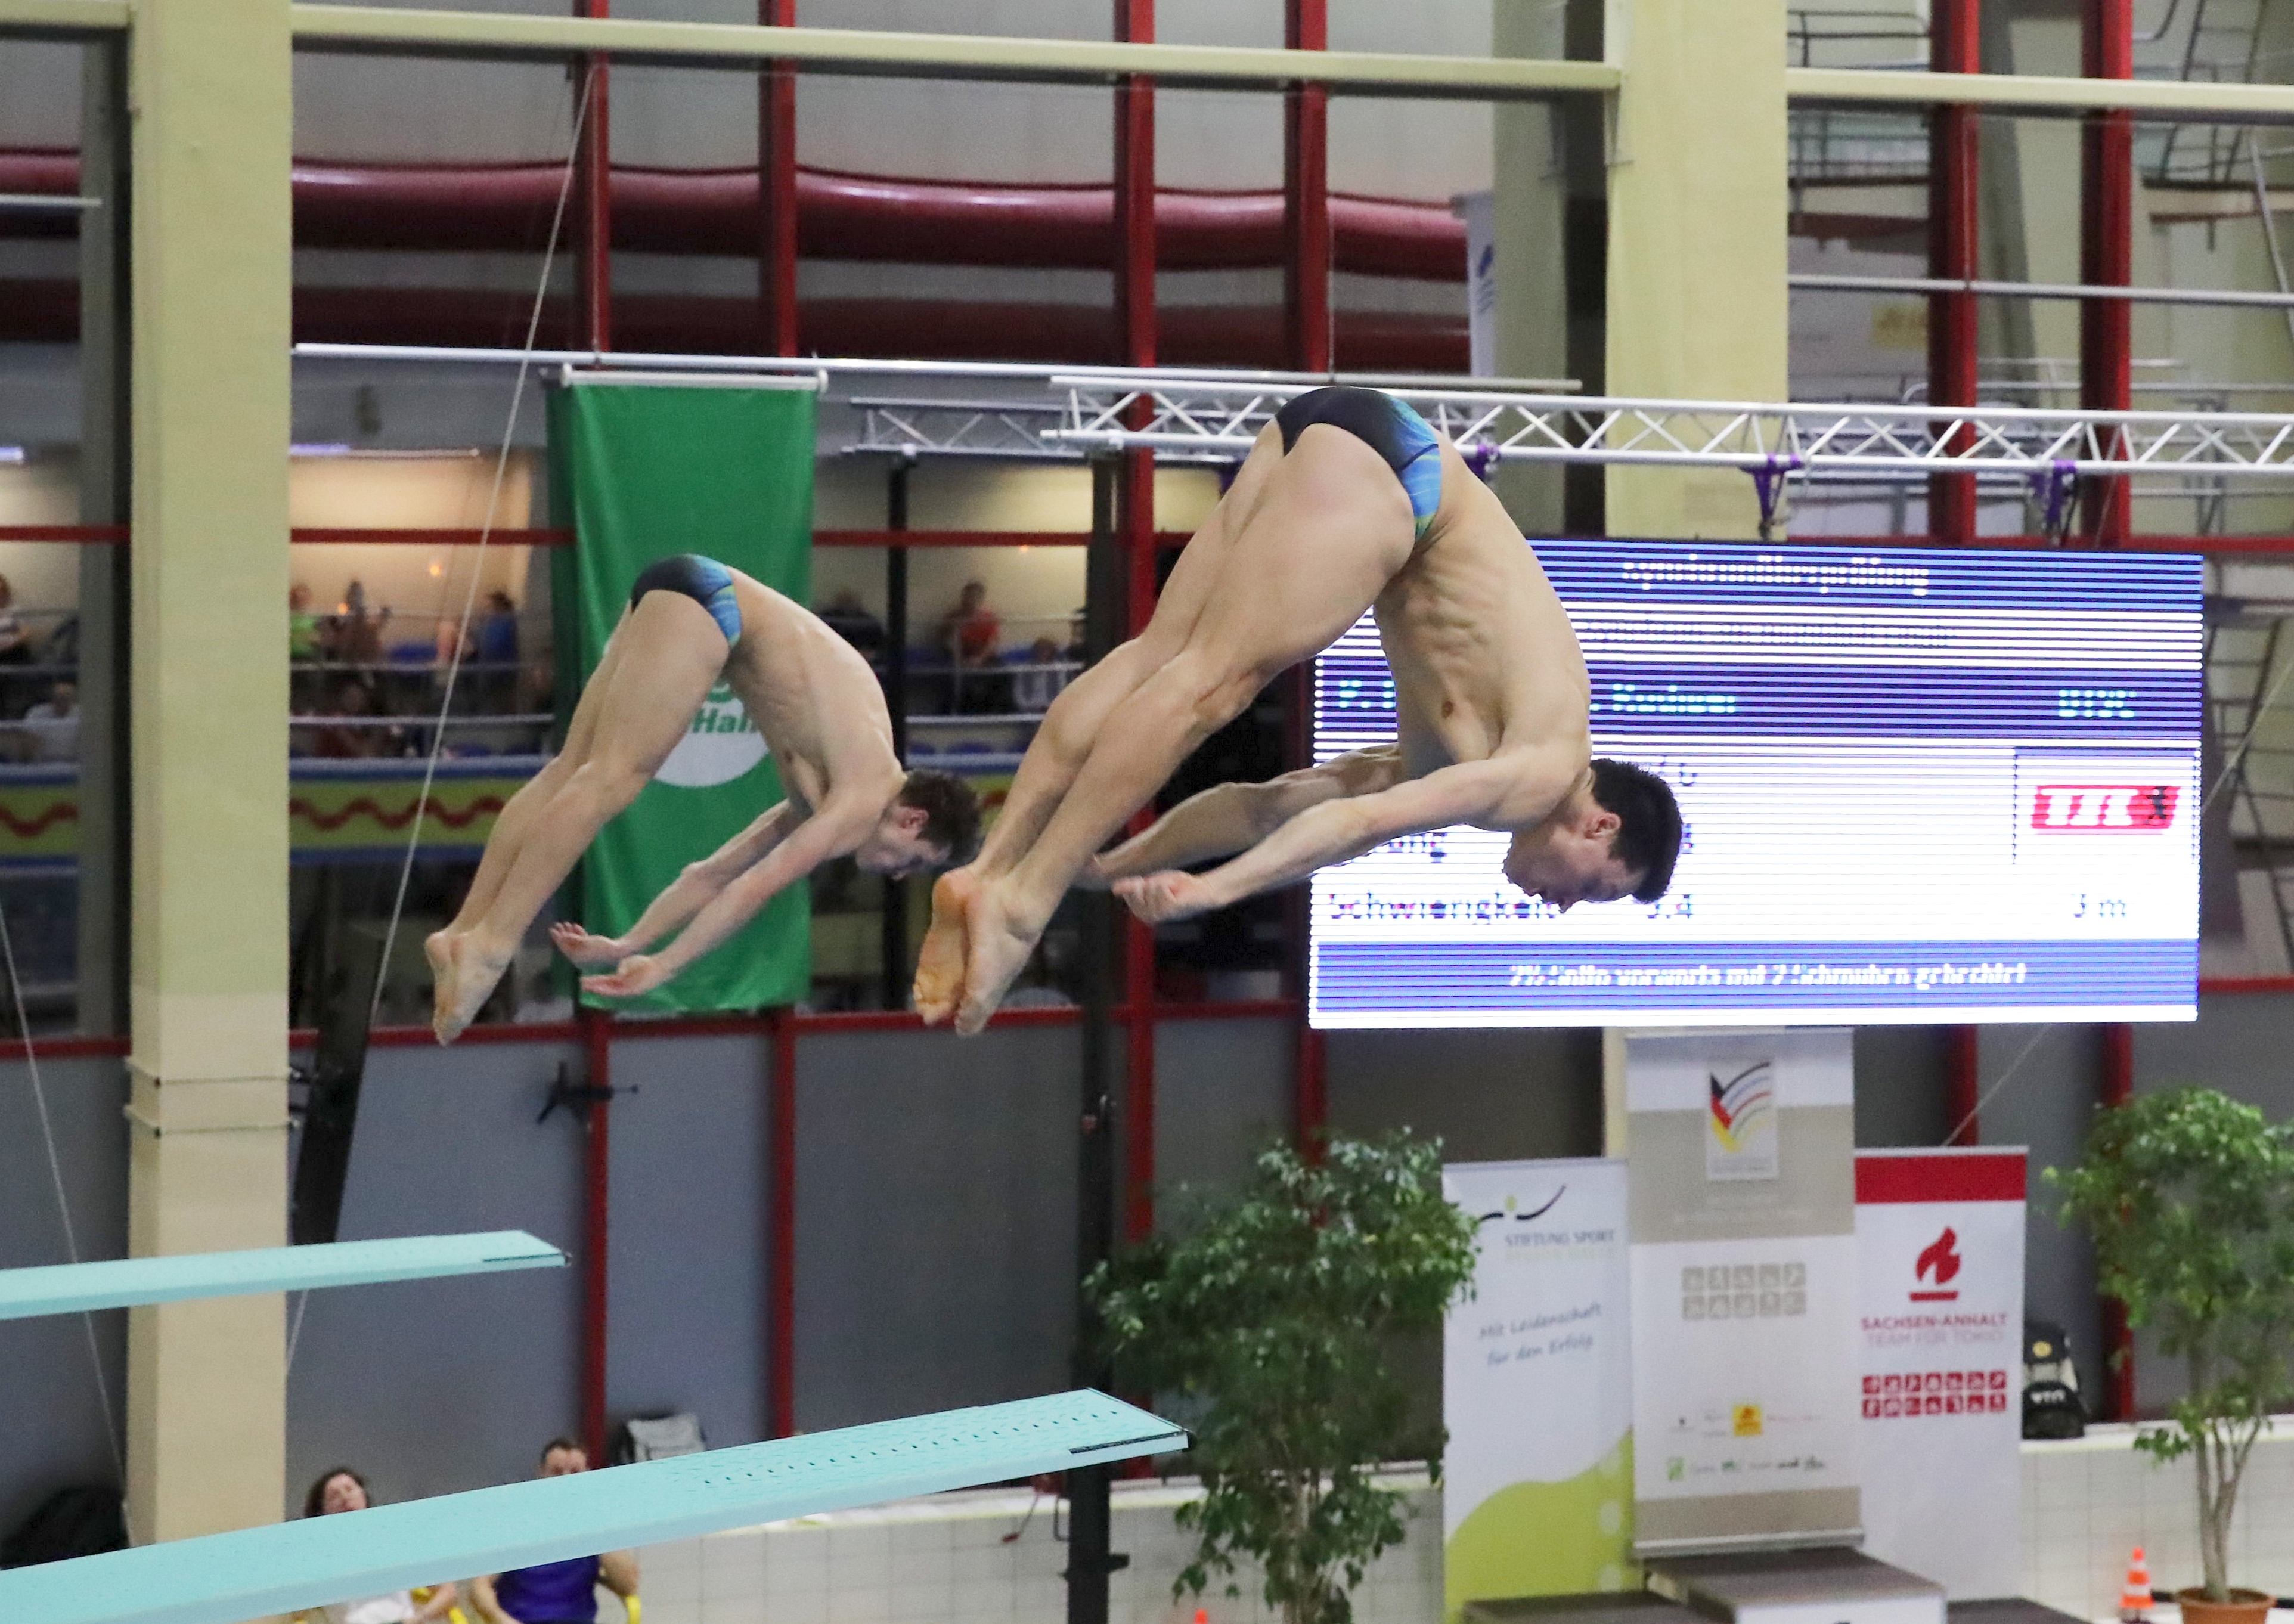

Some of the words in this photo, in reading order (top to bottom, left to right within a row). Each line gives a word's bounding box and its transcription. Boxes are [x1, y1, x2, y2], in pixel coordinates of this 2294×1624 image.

[1505, 1231, 1571, 1247] STIFTUNG
[1572, 1229, 1614, 1244] SPORT
[1510, 1301, 1602, 1334] Leidenschaft
[1861, 1313, 2008, 1331] SACHSEN-ANHALT
[1549, 1333, 1594, 1355] Erfolg
[1867, 1330, 1911, 1346] TEAM
